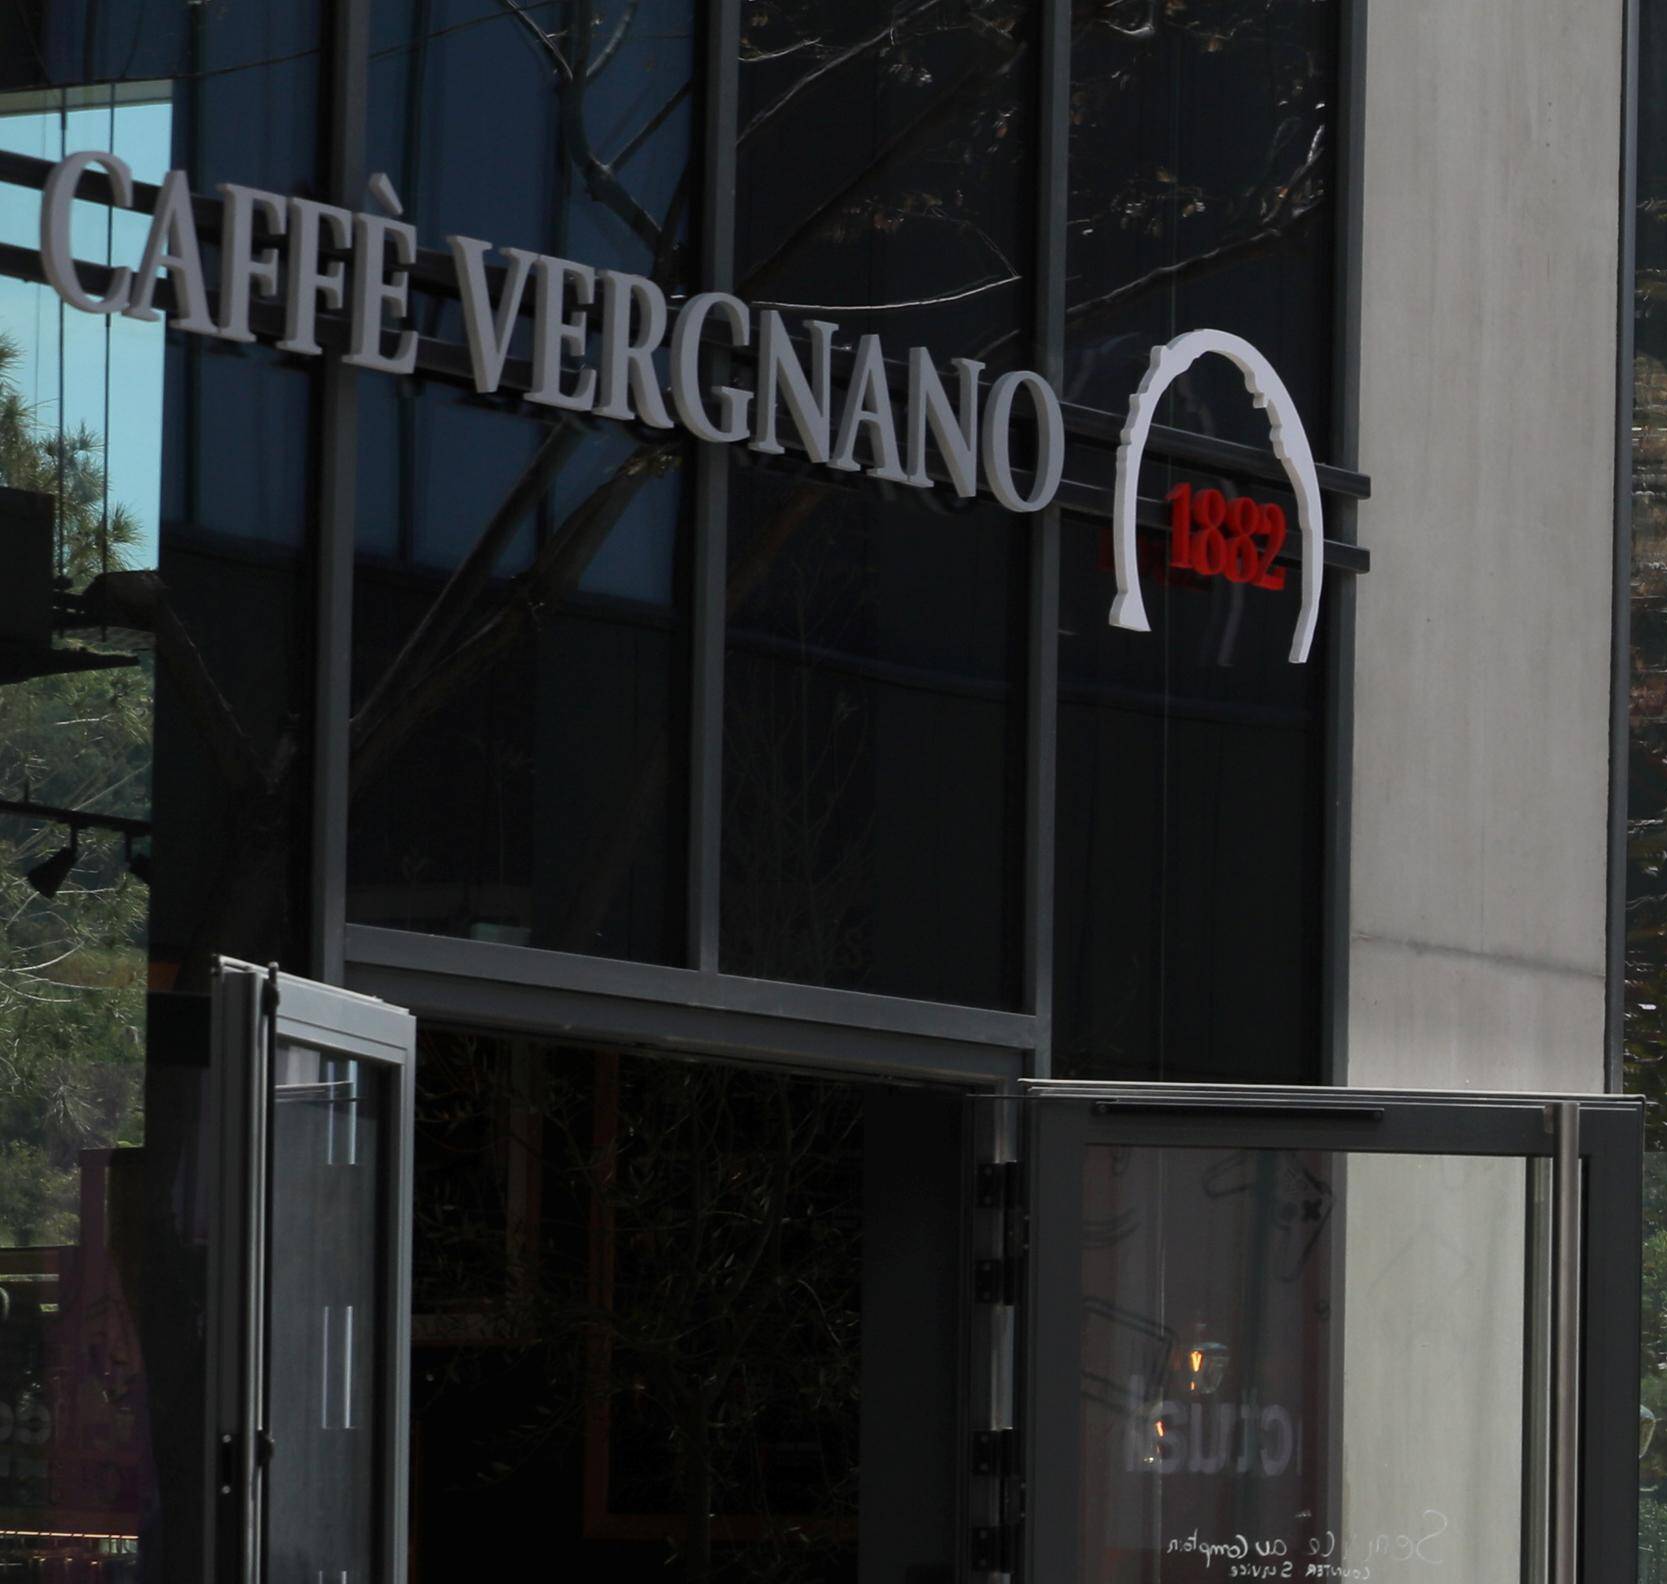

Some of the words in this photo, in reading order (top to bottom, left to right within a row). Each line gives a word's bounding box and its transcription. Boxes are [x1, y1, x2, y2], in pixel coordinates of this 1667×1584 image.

[40, 150, 418, 375] CAFFÈ
[447, 235, 1065, 513] VERGNANO
[1166, 482, 1287, 592] 1882
